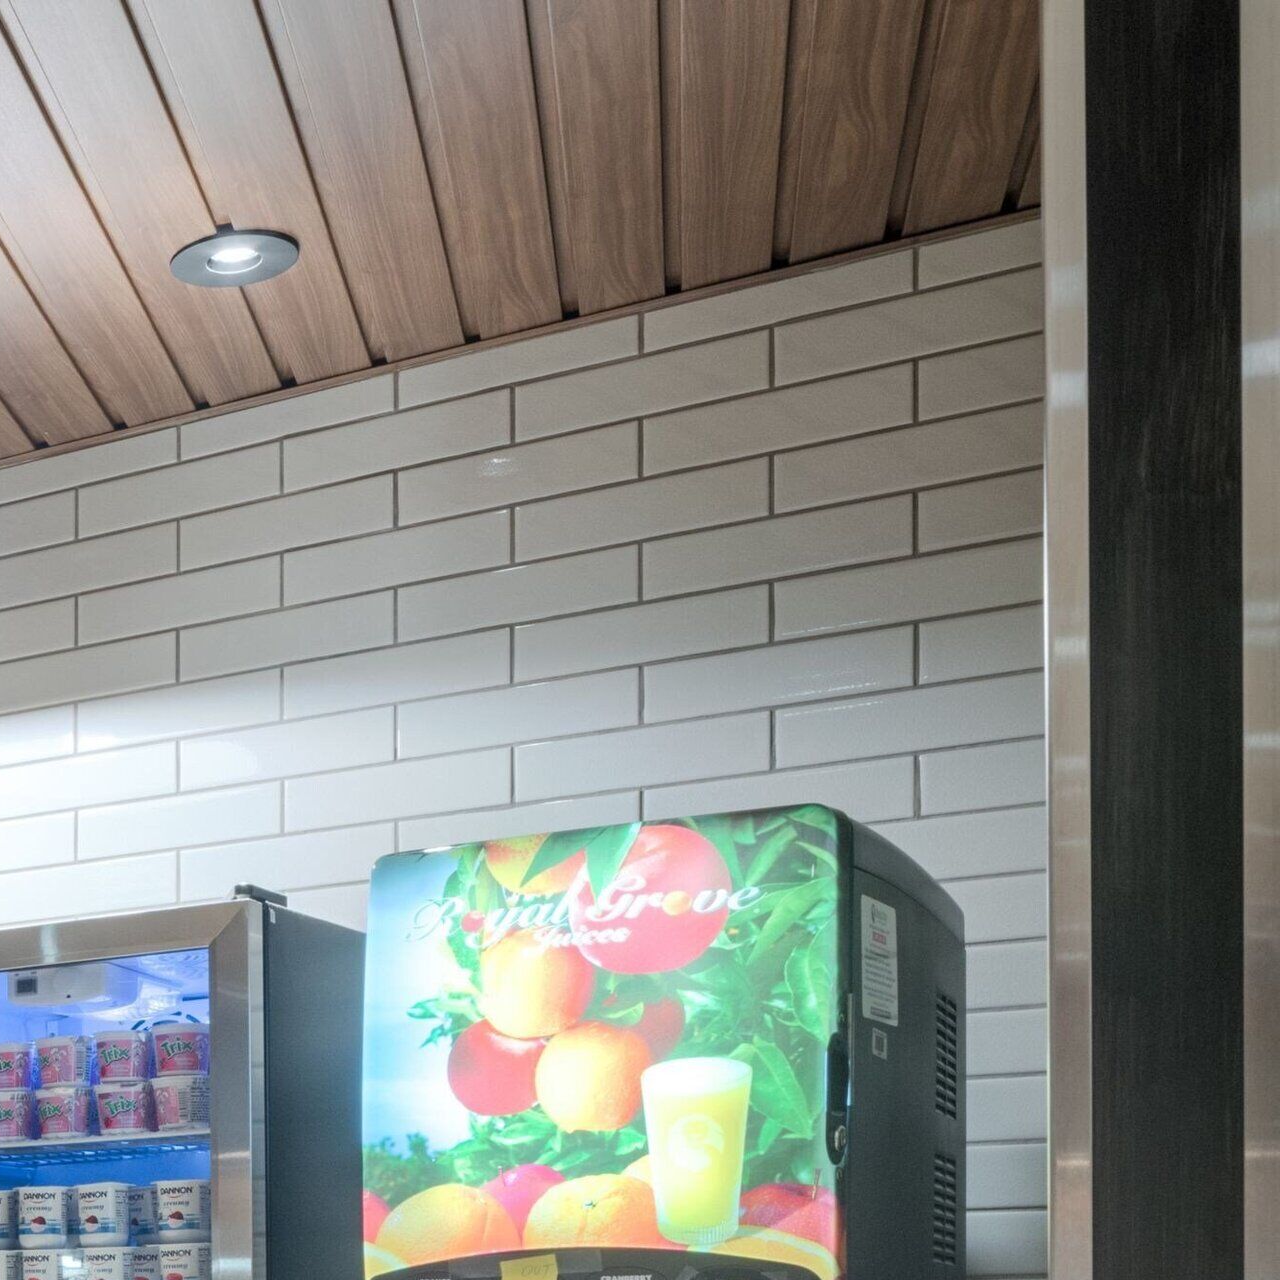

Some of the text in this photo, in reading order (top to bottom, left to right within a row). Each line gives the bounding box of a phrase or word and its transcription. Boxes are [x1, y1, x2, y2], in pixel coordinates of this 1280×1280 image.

[101, 1045, 130, 1065] Trix
[160, 1038, 194, 1057] Trix
[105, 1096, 137, 1116] Trix
[23, 1192, 56, 1200] DANNON
[160, 1186, 194, 1196] DANNON
